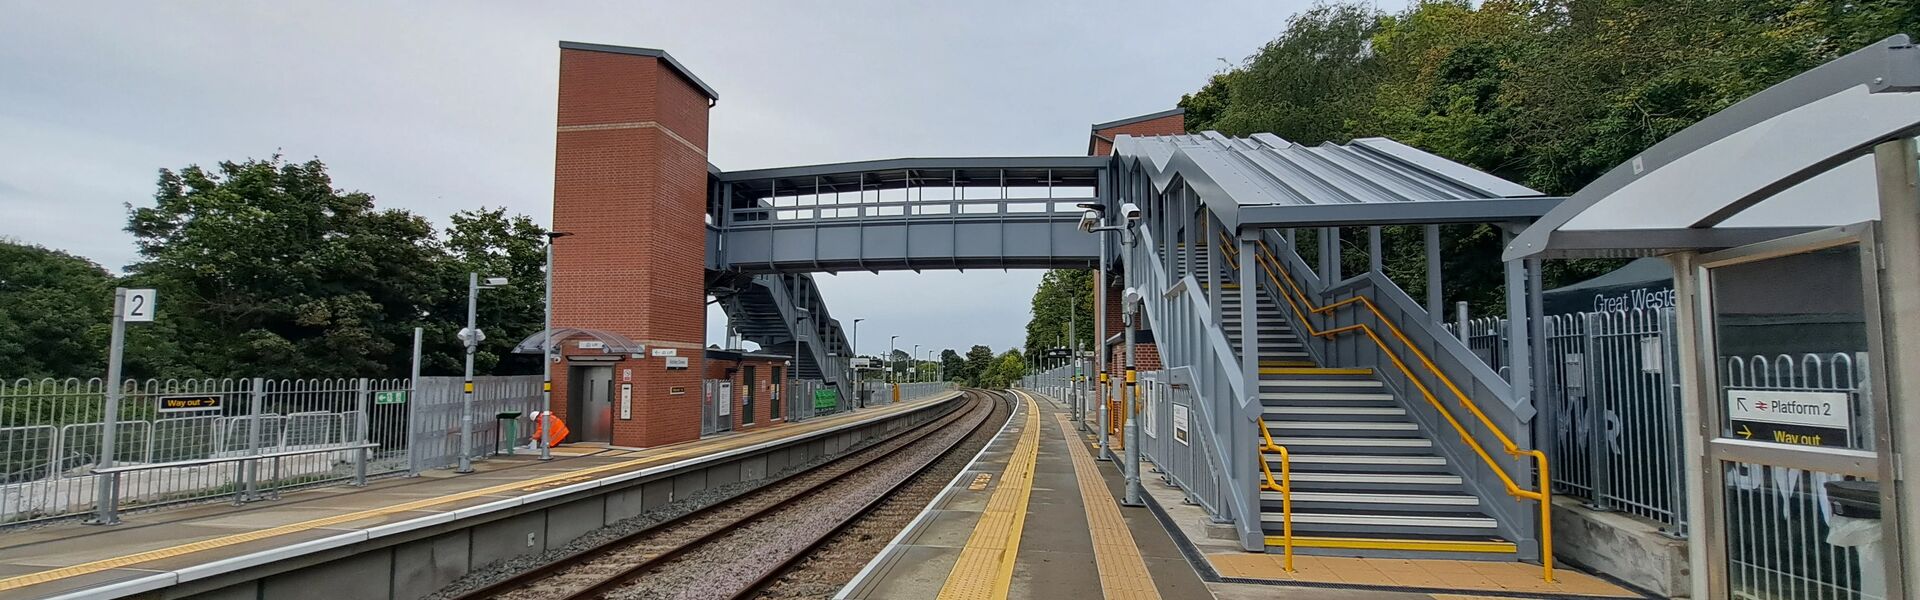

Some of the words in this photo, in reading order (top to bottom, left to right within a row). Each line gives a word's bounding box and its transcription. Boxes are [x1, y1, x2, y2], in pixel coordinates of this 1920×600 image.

[131, 294, 144, 316] 2
[1594, 293, 1629, 313] Great
[167, 399, 186, 408] Way
[1771, 400, 1820, 416] Platform
[1823, 403, 1831, 416] 2
[1773, 430, 1798, 444] Way
[1801, 435, 1821, 446] out
